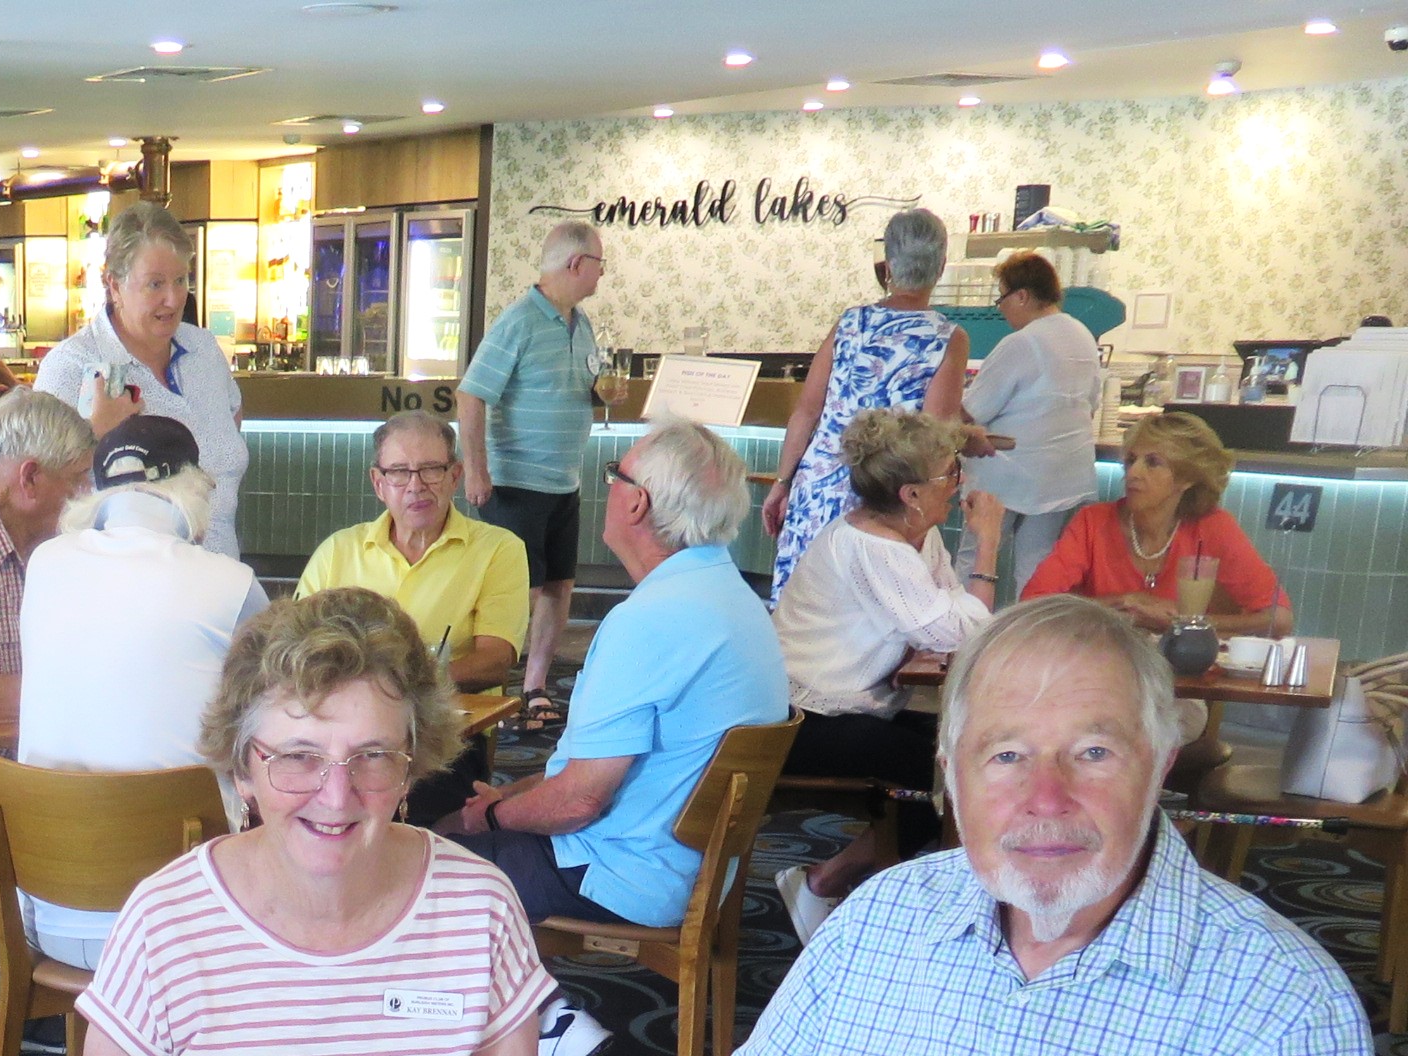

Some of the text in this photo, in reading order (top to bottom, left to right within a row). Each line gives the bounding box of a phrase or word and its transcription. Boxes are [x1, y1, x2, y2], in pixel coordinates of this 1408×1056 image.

[558, 176, 884, 227] emerald lakes
[381, 386, 458, 413] No S
[1274, 490, 1313, 525] 44
